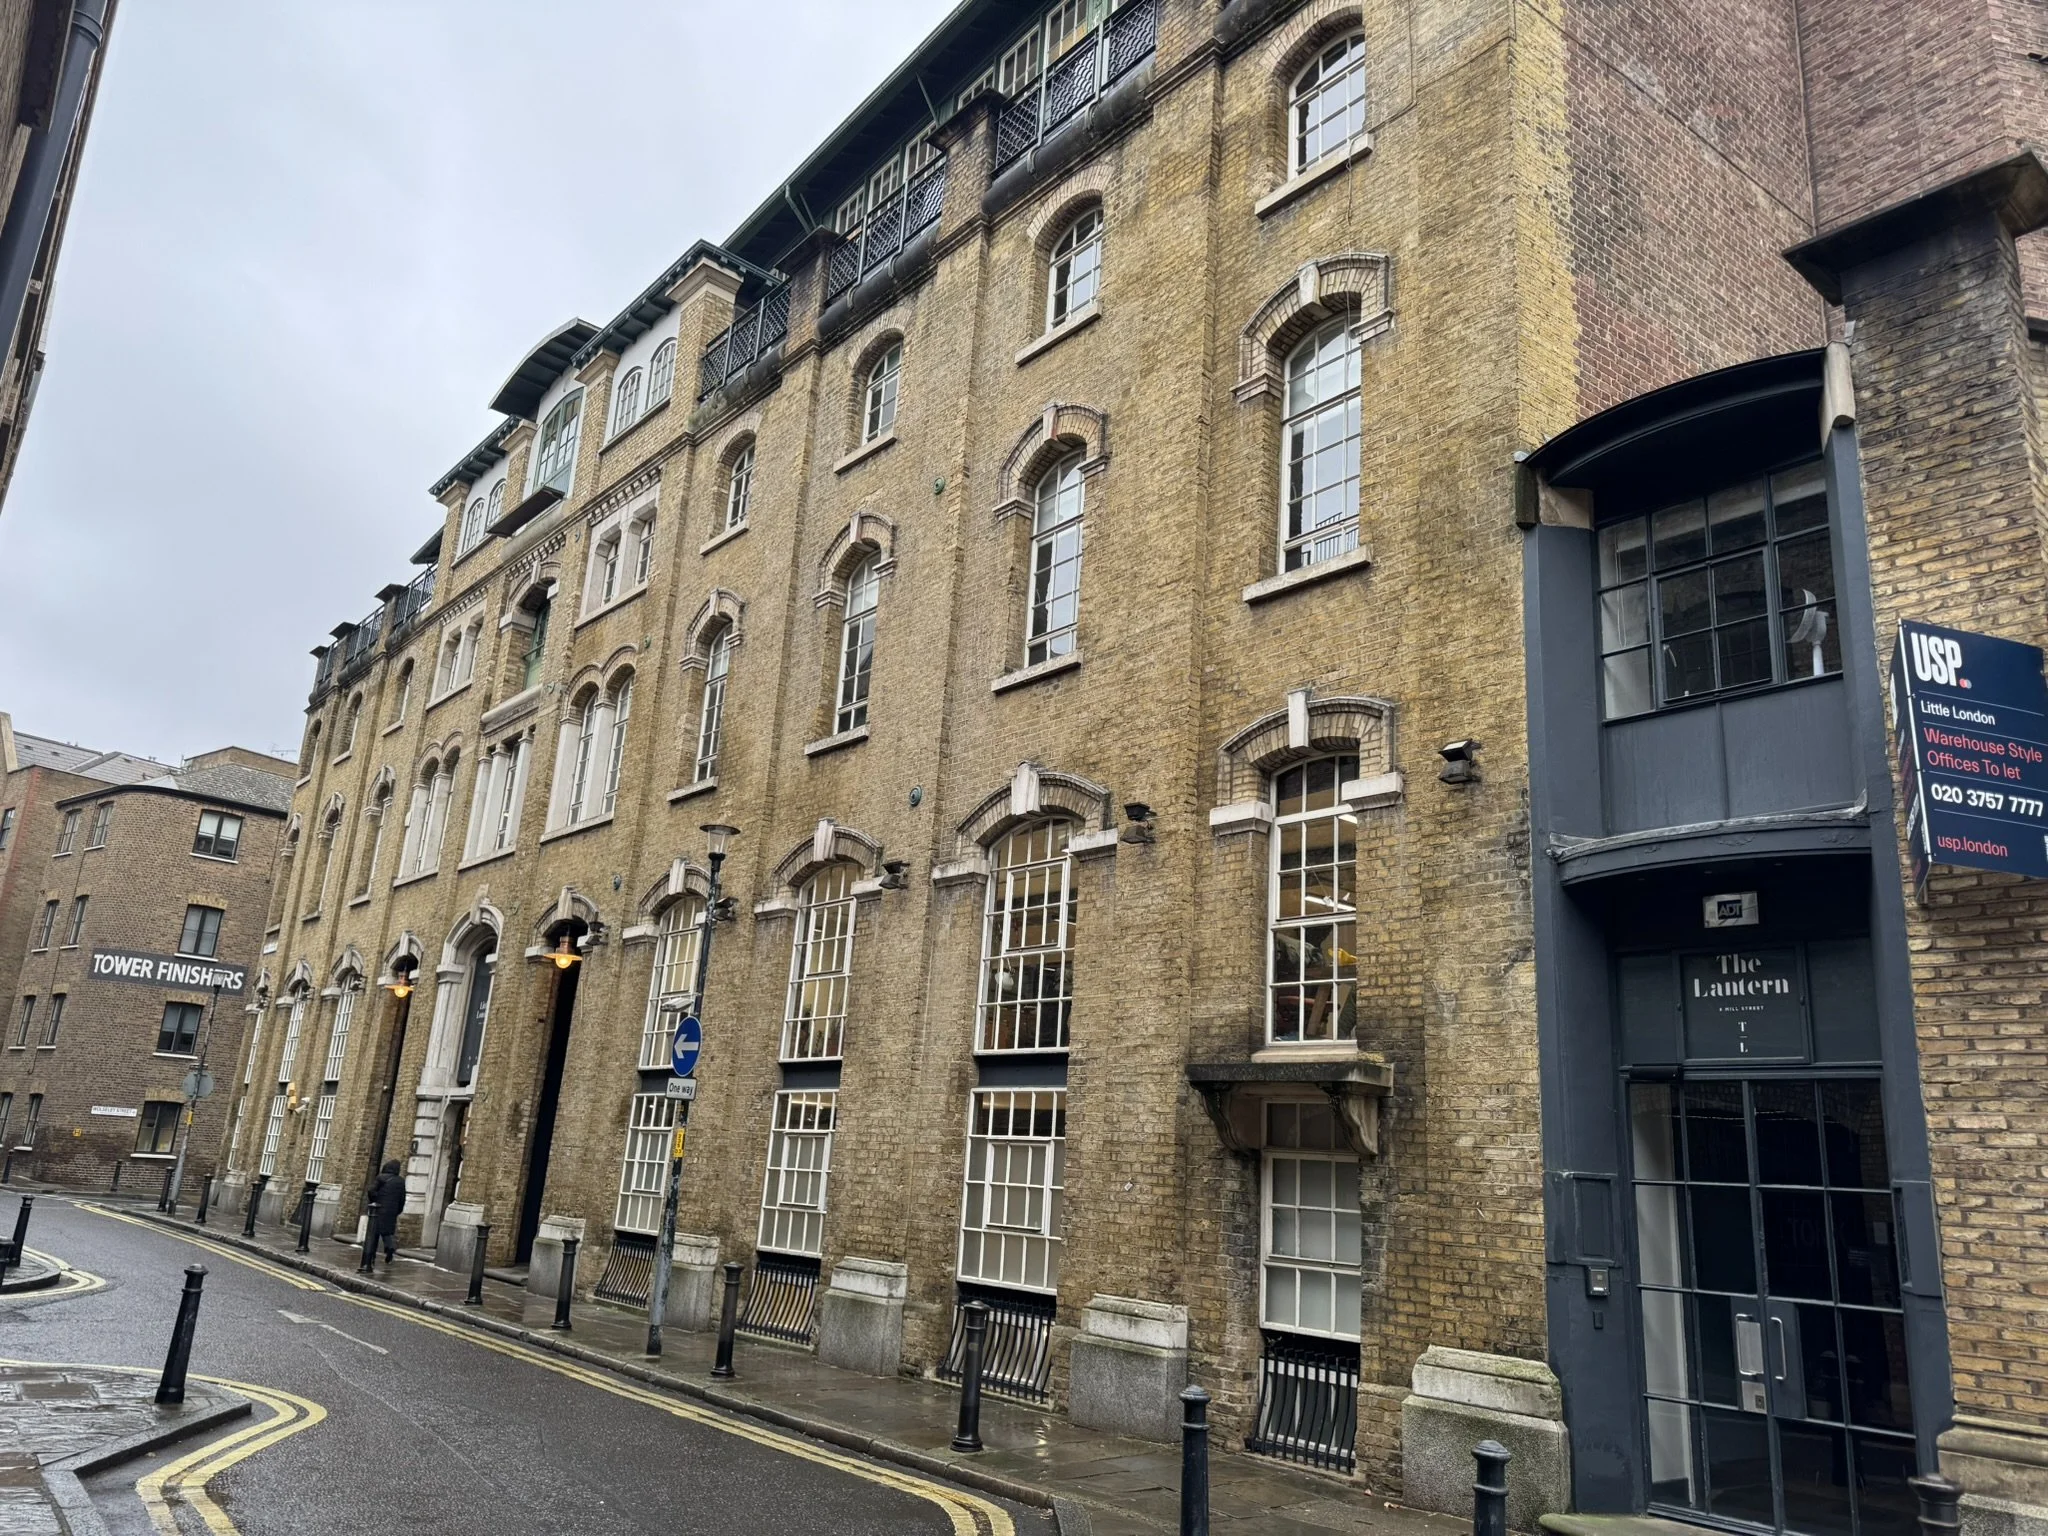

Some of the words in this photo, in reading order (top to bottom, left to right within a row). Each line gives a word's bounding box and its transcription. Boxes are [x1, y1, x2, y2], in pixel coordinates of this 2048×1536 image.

[1920, 699, 1950, 717] Little
[1952, 705, 1996, 725] London
[1923, 727, 2005, 756] Warehouse
[2008, 742, 2043, 764] Style
[1927, 750, 1980, 773] Offices
[1981, 759, 2000, 776] To
[2003, 762, 2022, 780] let
[1931, 783, 1963, 804] 020
[1966, 788, 2004, 811] 3757
[2008, 795, 2044, 817] 7777
[1937, 835, 2008, 857] usp.london
[1718, 903, 1742, 917] ADT
[93, 953, 154, 979] TOWER
[1716, 953, 1762, 975] The
[1693, 978, 1790, 997] Lantern
[1738, 1021, 1747, 1032] T
[669, 1082, 680, 1093] One
[682, 1085, 694, 1096] way
